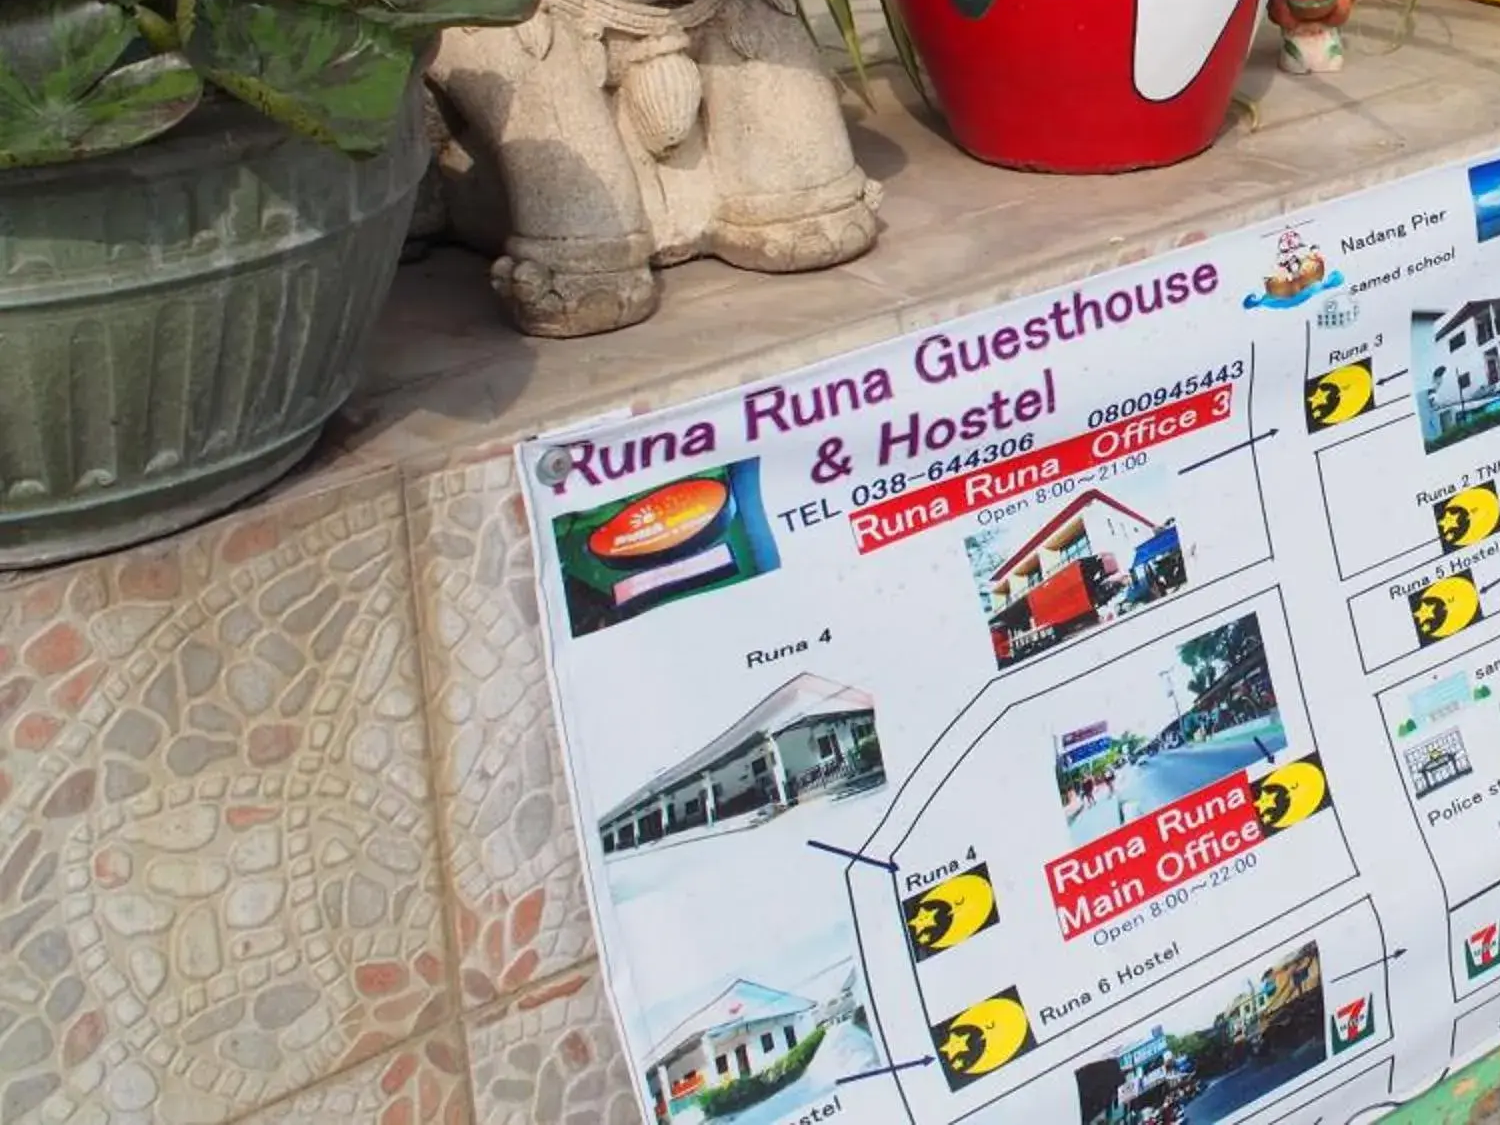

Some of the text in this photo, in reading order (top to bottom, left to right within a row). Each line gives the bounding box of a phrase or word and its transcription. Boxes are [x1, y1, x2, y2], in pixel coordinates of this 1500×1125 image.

[1341, 209, 1448, 254] Nadang Pier
[1350, 247, 1456, 297] samed school
[1329, 333, 1384, 365] Runa 3
[554, 262, 1219, 495] Runa Runa Guesthouse
[778, 360, 1245, 534] TEL 038-644306 0800945443
[810, 368, 1056, 484] & Hostel
[853, 389, 1231, 553] Runa Runa Office 3
[1416, 482, 1457, 507] Runa
[1461, 474, 1470, 487] 2
[977, 498, 1029, 526] Open
[1389, 542, 1500, 599] Runa 5 Hostel
[746, 627, 832, 668] Runa 4
[1427, 792, 1484, 827] Police
[1053, 785, 1246, 894] Runa Runa
[906, 845, 977, 892] Runa 4
[1058, 819, 1262, 935] Main Office
[1093, 914, 1145, 947] Open
[1040, 941, 1181, 1026] Runa 6 Hostel
